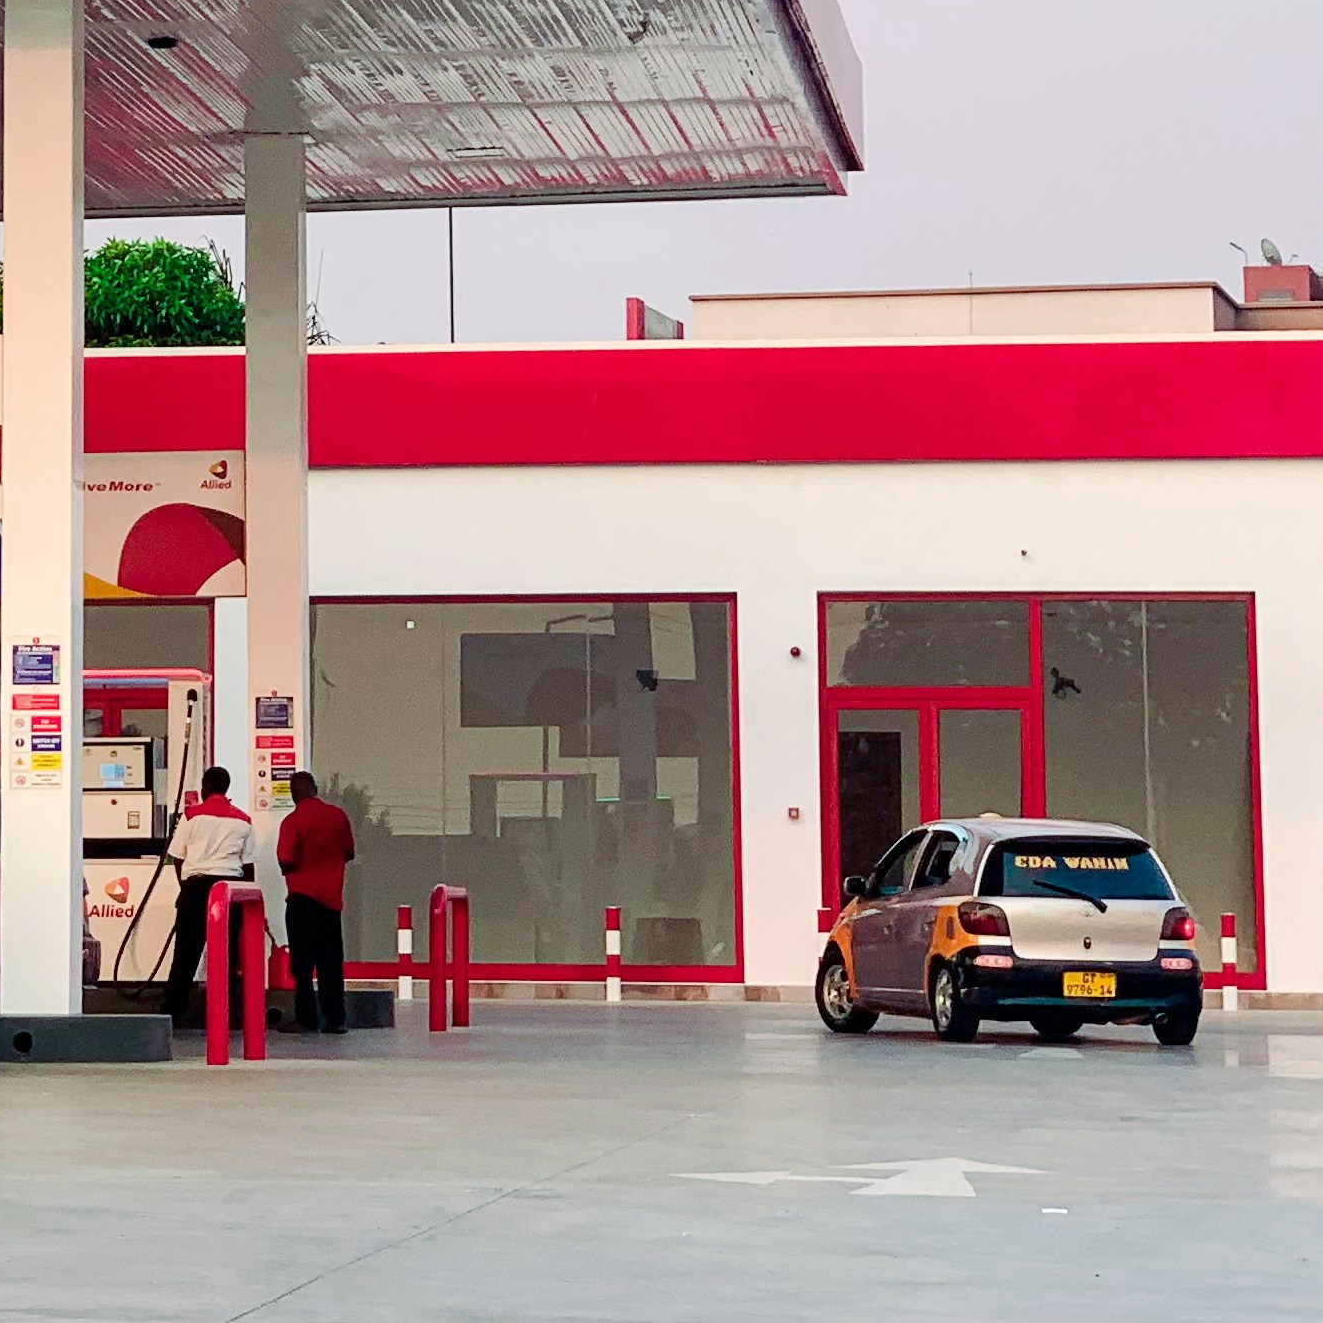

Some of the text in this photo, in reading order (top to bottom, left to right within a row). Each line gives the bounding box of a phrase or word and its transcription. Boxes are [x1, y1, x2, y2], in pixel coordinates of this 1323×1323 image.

[109, 480, 154, 492] More
[200, 479, 232, 490] Allied
[88, 904, 134, 918] Allied
